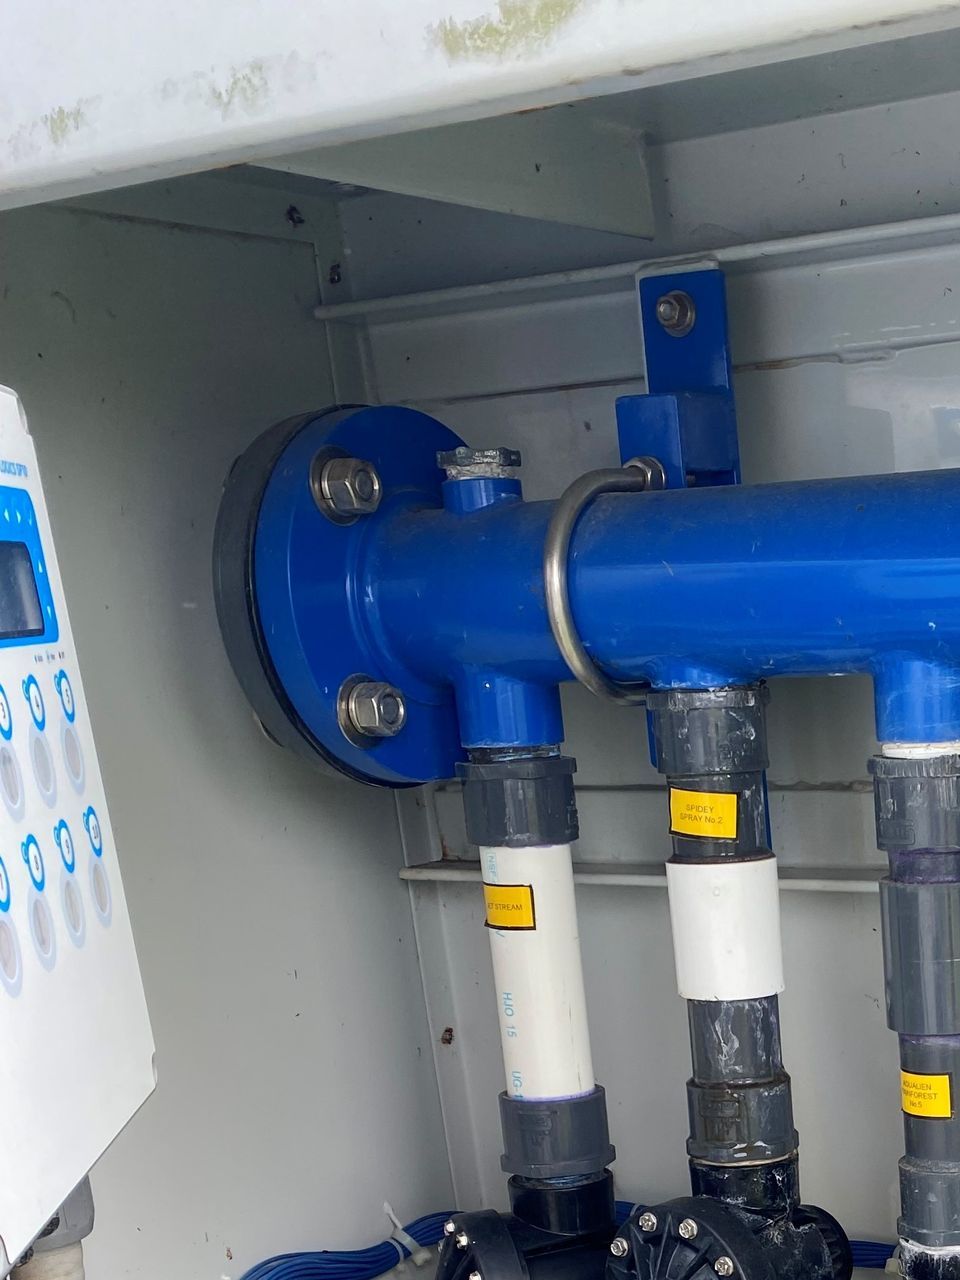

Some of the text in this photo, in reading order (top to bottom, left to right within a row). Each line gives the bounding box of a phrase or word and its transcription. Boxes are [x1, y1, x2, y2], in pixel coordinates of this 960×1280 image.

[686, 804, 714, 814] SPIDEY
[680, 812, 703, 823] SPRAY
[495, 903, 523, 911] STREAM
